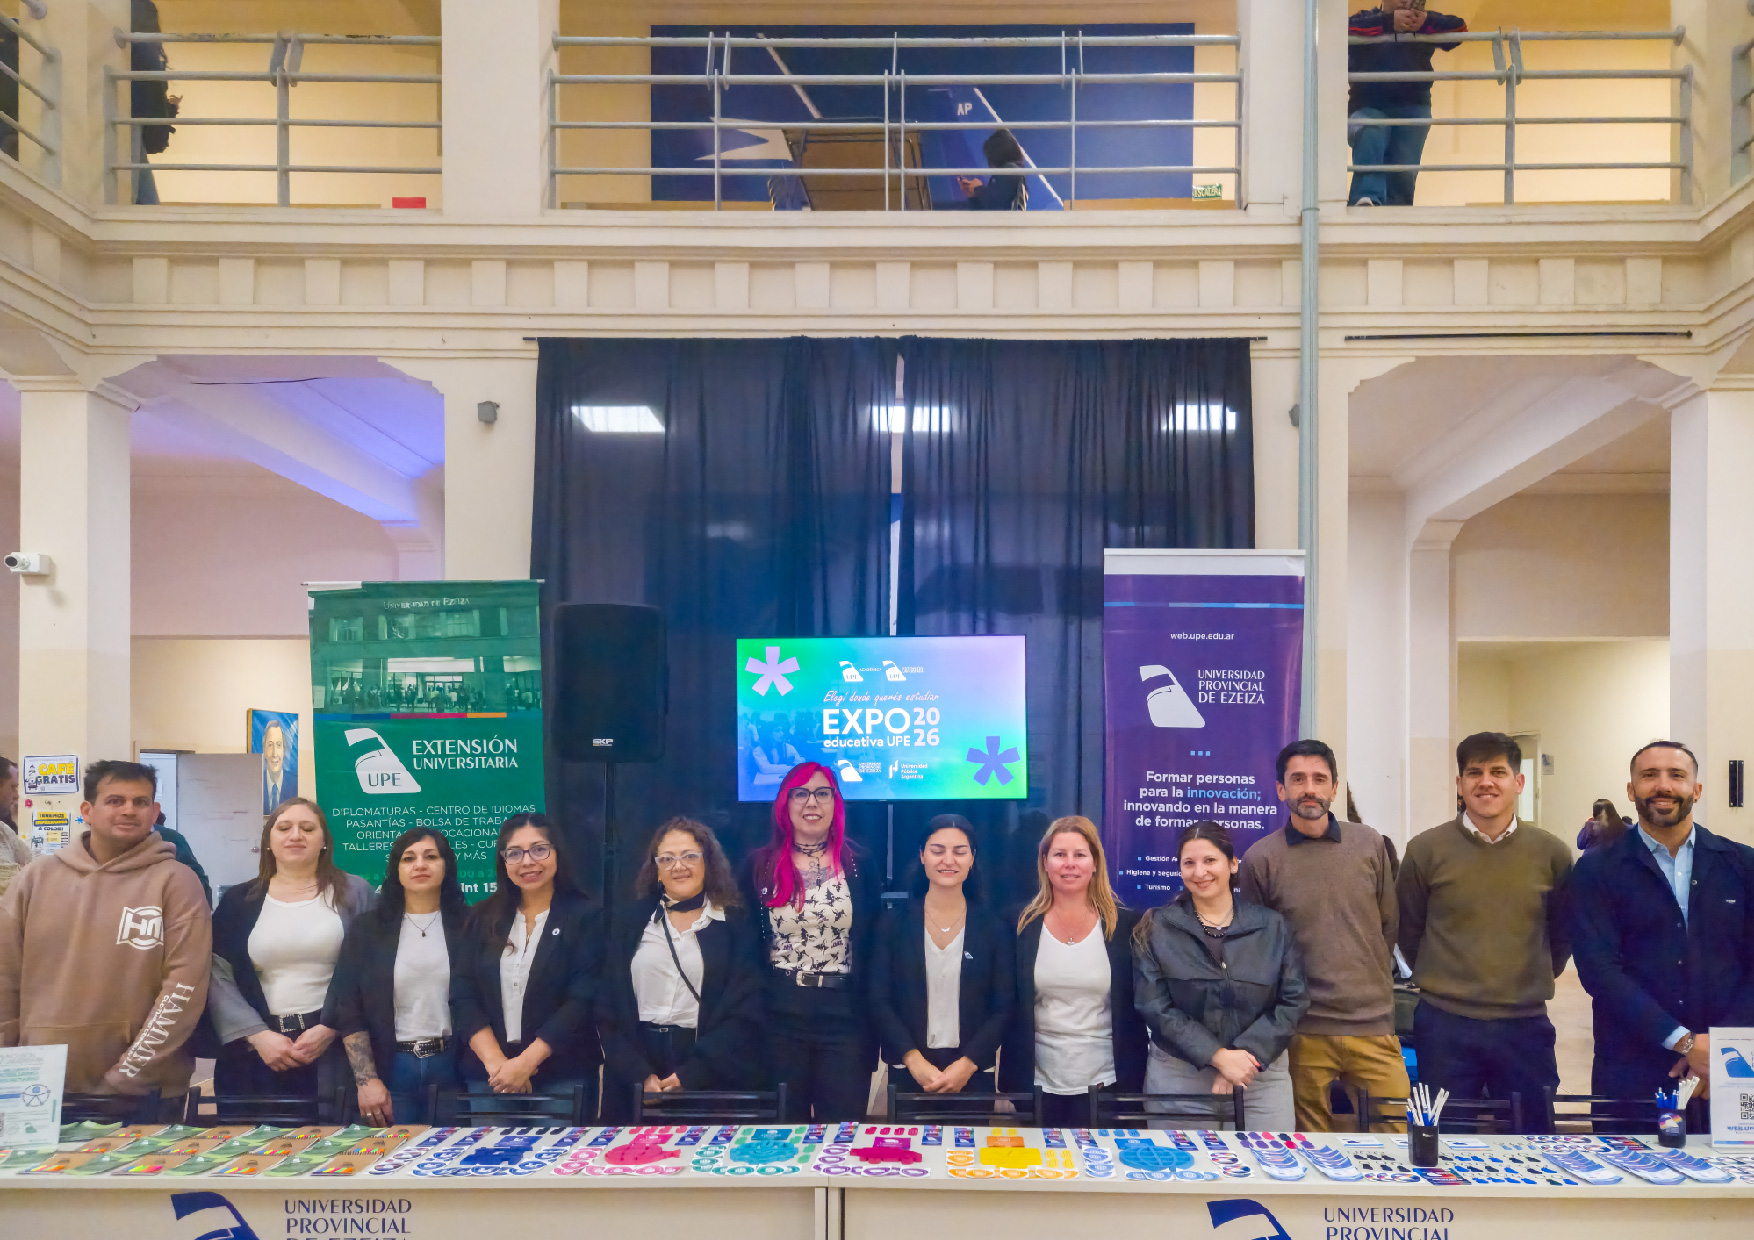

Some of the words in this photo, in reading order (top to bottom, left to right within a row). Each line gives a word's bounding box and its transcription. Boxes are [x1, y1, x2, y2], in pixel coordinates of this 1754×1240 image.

[1170, 632, 1234, 641] web.upe.edu.ar
[1197, 669, 1265, 680] UNIVERSIDAD
[1198, 680, 1265, 692] PROVINCIAL
[905, 690, 939, 702] estudiar
[1198, 691, 1216, 704] DE
[1220, 692, 1265, 704] EZEIZA
[823, 707, 911, 735] EXPO
[913, 706, 940, 726] 20
[823, 735, 884, 748] educativa
[887, 735, 911, 747] UPE
[913, 727, 940, 747] 26
[412, 734, 518, 755] EXTENSIÓN
[413, 756, 519, 770] UNIVERSITARIA
[36, 774, 76, 785] GRATIS
[368, 772, 401, 787] UPE
[1146, 770, 1193, 783] Formar
[1196, 773, 1256, 785] personas
[1139, 786, 1168, 798] para
[1172, 785, 1184, 798] la
[1187, 786, 1261, 801] innovación;
[426, 805, 471, 815] CENTRO
[473, 805, 488, 815] DE
[491, 804, 536, 814] IDIOMAS
[1123, 799, 1191, 813] innovando
[1194, 803, 1210, 814] en
[1213, 801, 1225, 814] la
[1228, 804, 1277, 815] manera
[346, 817, 406, 829] PASANTÍAS
[416, 818, 452, 827] BOLSA
[455, 817, 470, 826] DE
[1135, 814, 1152, 827] de
[1202, 819, 1265, 830] rsonas.
[463, 850, 487, 860] MÁS
[460, 882, 479, 893] Int
[284, 1198, 412, 1214] UNIVERSIDAD
[1324, 1207, 1454, 1223] UNIVERSIDAD
[286, 1217, 412, 1234] PROVINCIAL
[1326, 1226, 1450, 1240] PROVINCIAL
